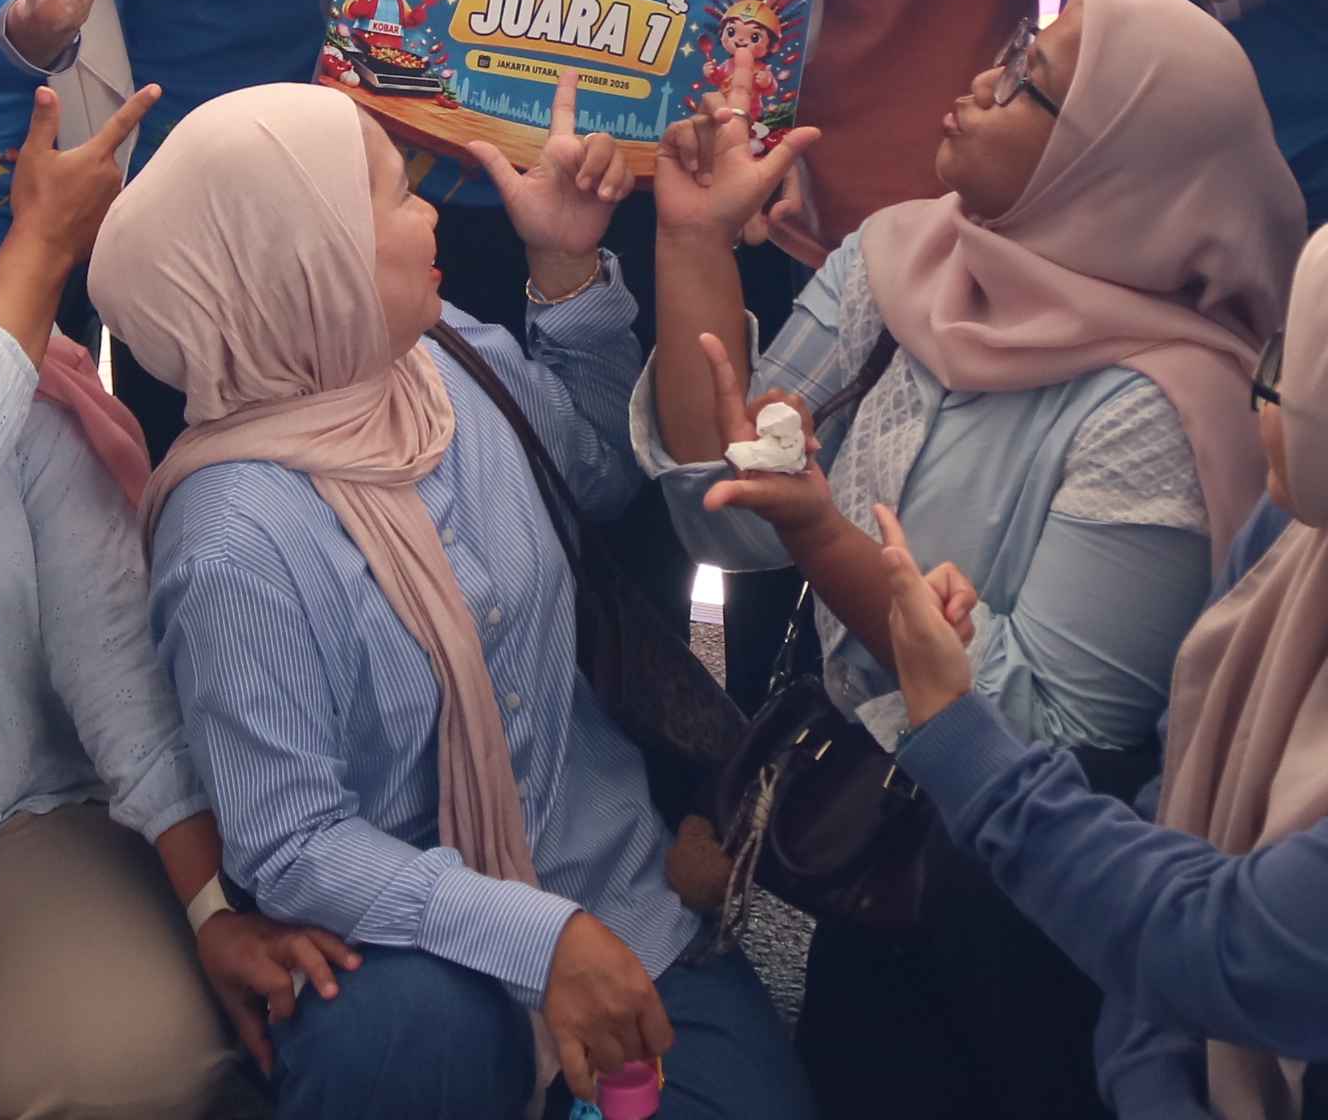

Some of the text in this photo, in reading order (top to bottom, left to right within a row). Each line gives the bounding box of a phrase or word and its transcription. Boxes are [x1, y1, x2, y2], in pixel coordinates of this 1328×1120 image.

[373, 22, 400, 33] KOBAR
[638, 12, 673, 65] 1
[497, 60, 530, 73] JAKARTA
[532, 65, 560, 78] UTARA,
[577, 74, 609, 86] KTOBER
